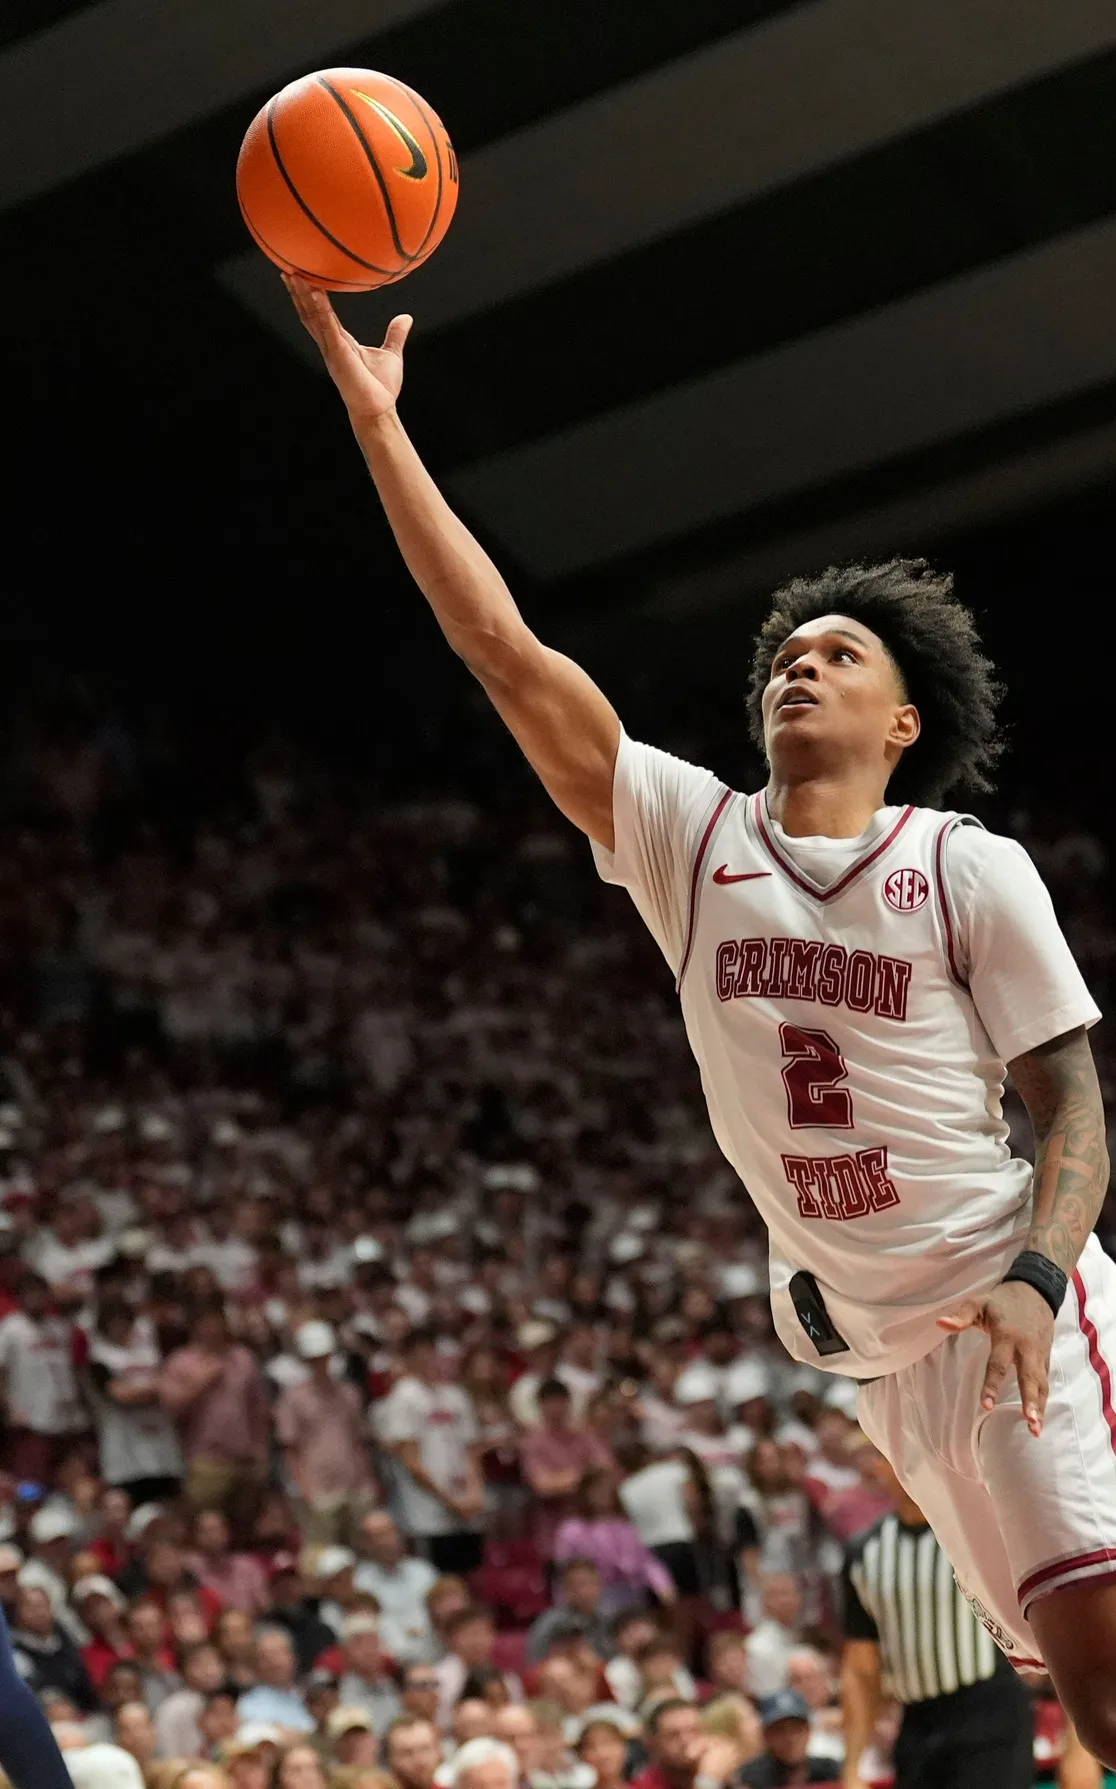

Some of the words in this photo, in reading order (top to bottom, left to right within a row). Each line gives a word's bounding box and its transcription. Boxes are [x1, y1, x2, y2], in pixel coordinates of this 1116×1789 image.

[887, 870, 926, 908] SEC
[716, 937, 912, 1021] CRIMSON
[778, 1021, 854, 1129] 2
[780, 1146, 901, 1221] TIDE
